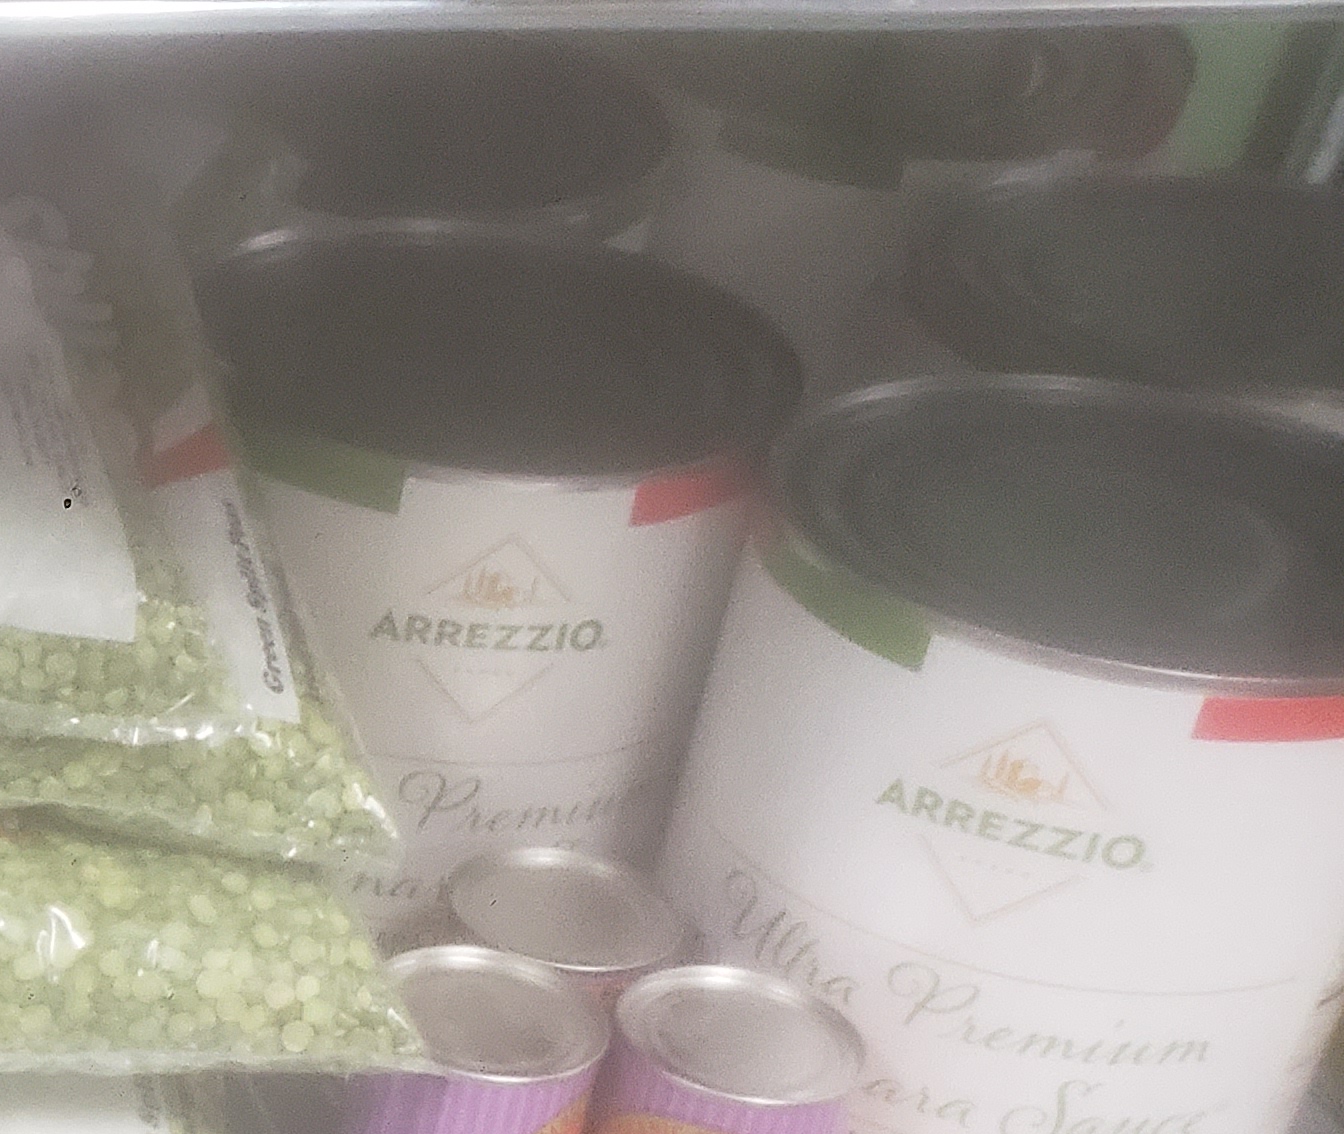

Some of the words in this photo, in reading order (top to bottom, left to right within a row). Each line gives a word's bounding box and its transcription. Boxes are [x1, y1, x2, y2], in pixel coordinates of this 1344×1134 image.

[255, 616, 285, 693] Green
[368, 607, 605, 653] ARREZZIO
[875, 776, 1148, 871] ARREZZIO
[723, 868, 859, 1004] Ultra
[886, 960, 1211, 1066] Premium
